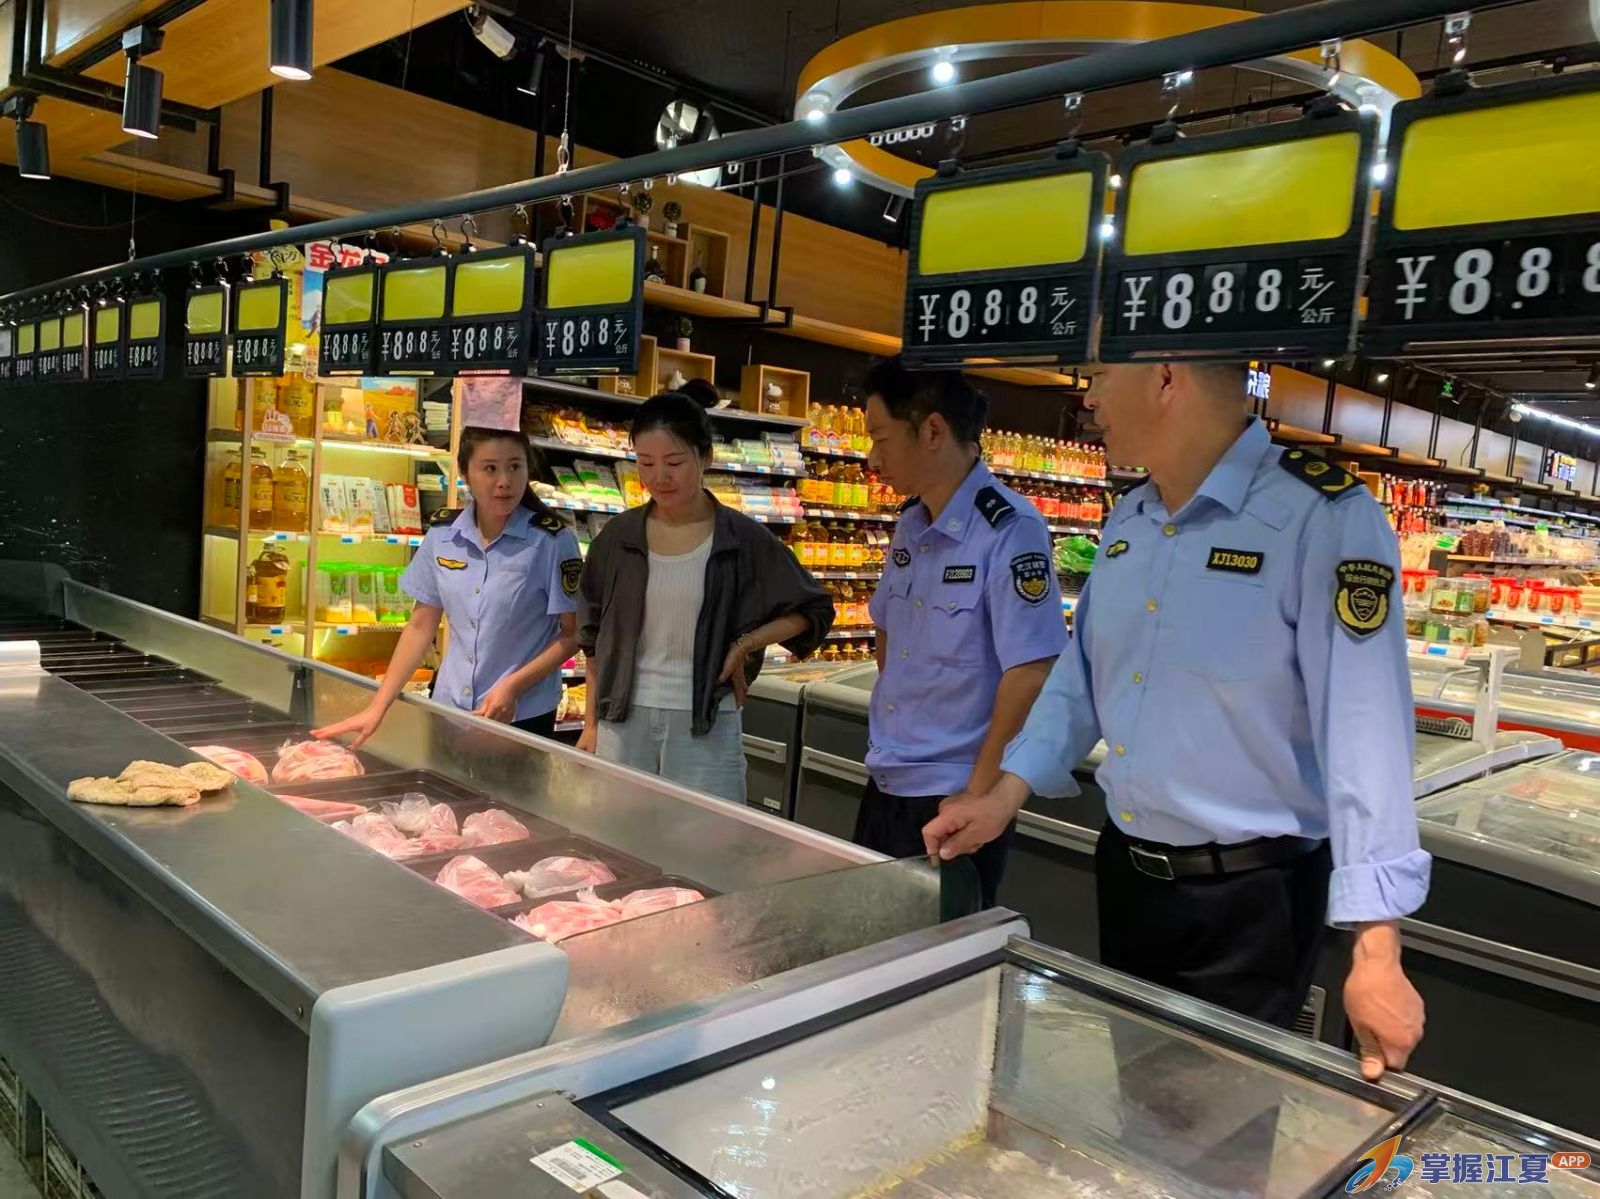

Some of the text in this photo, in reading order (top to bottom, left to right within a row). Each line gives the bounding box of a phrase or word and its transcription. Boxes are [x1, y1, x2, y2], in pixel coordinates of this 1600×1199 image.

[918, 287, 1039, 343] ¥8.88
[1123, 268, 1283, 332] ¥8.88
[546, 318, 609, 357] ¥8.88
[1212, 551, 1258, 569] XJ13030
